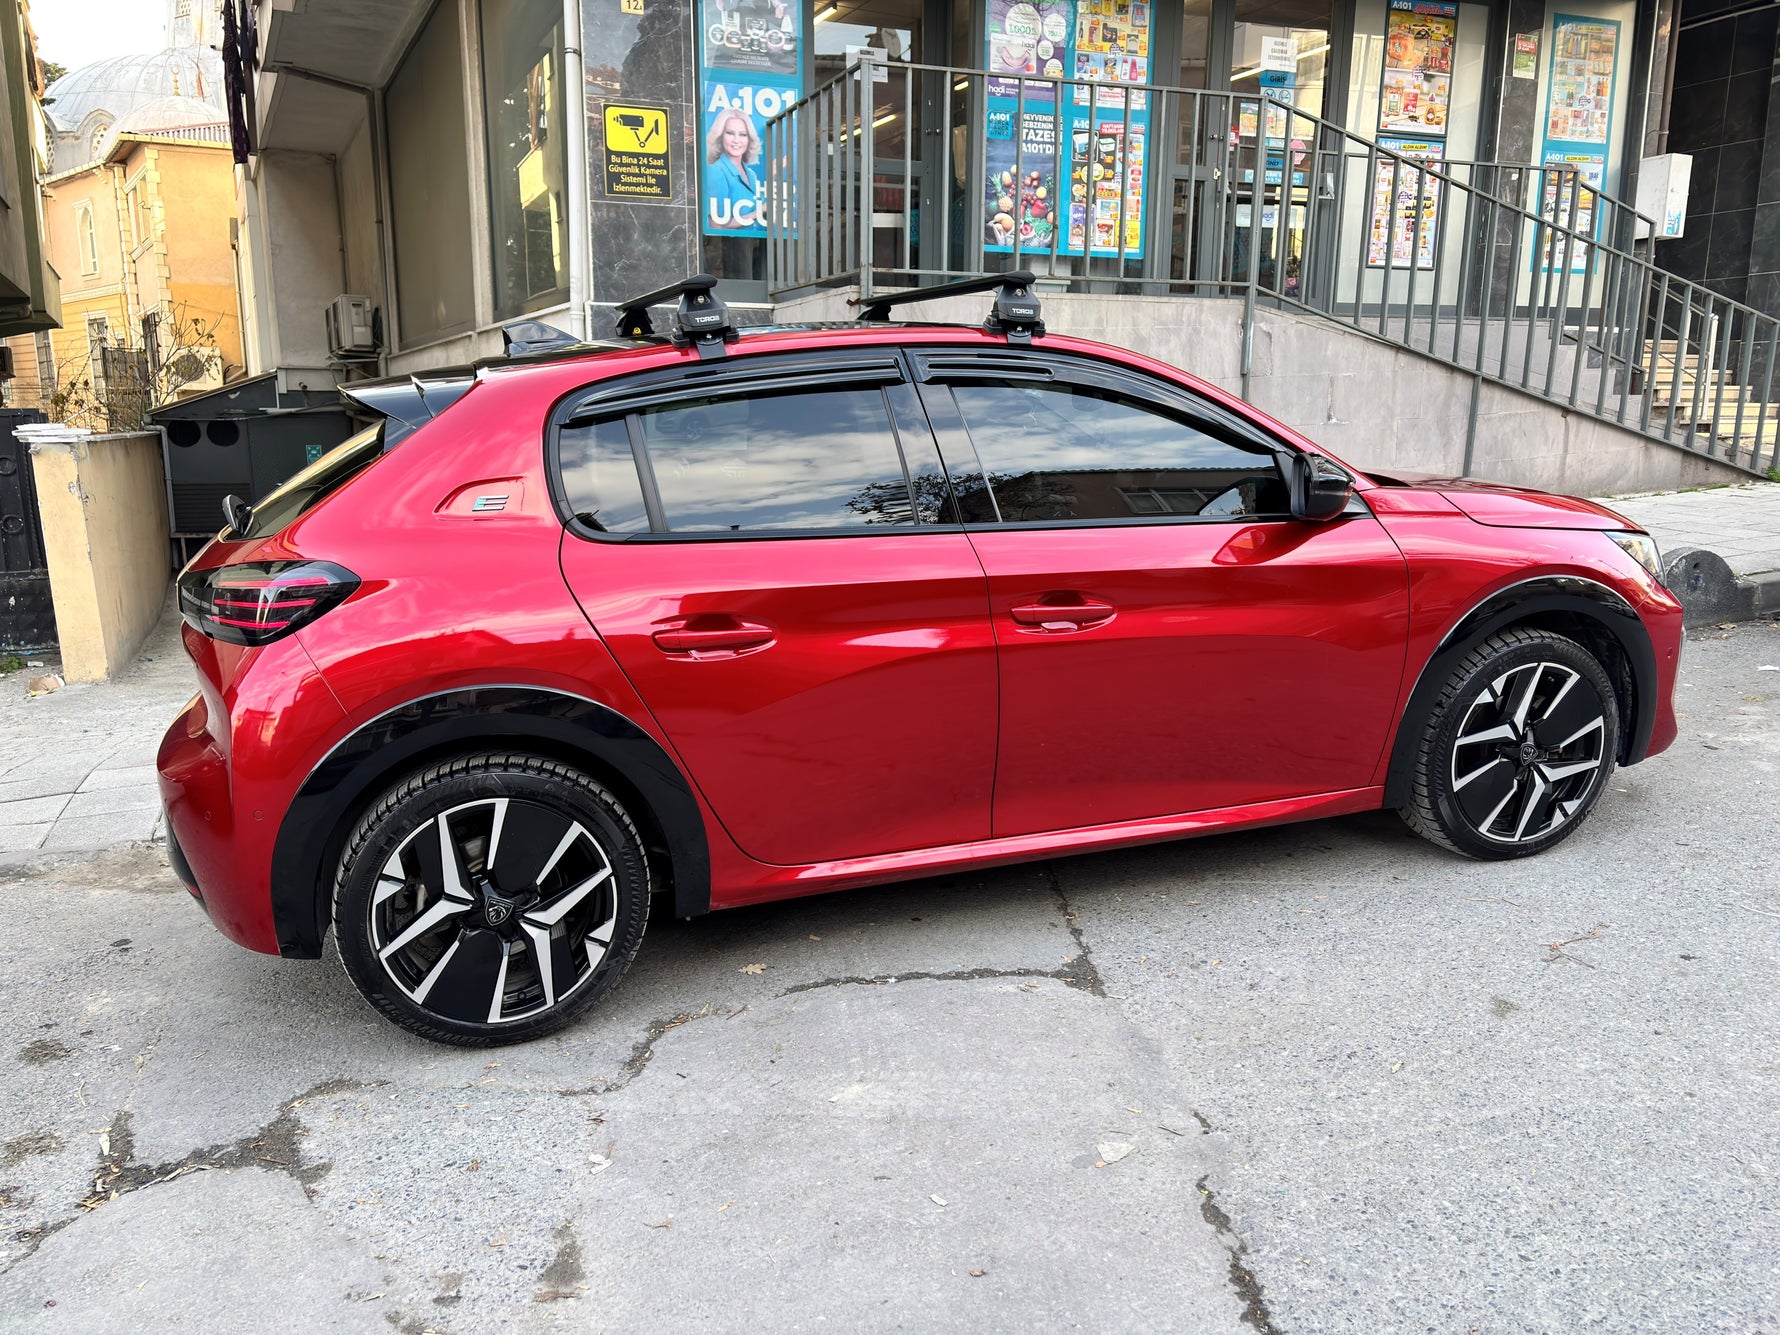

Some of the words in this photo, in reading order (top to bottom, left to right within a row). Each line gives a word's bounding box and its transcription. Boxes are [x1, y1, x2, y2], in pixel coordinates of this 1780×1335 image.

[611, 155, 620, 163] Bu
[622, 156, 637, 164] Bina
[649, 158, 664, 166] Saat
[609, 164, 640, 173] Güvenlik
[641, 166, 667, 175] Kamera
[620, 174, 646, 183] Sistemi
